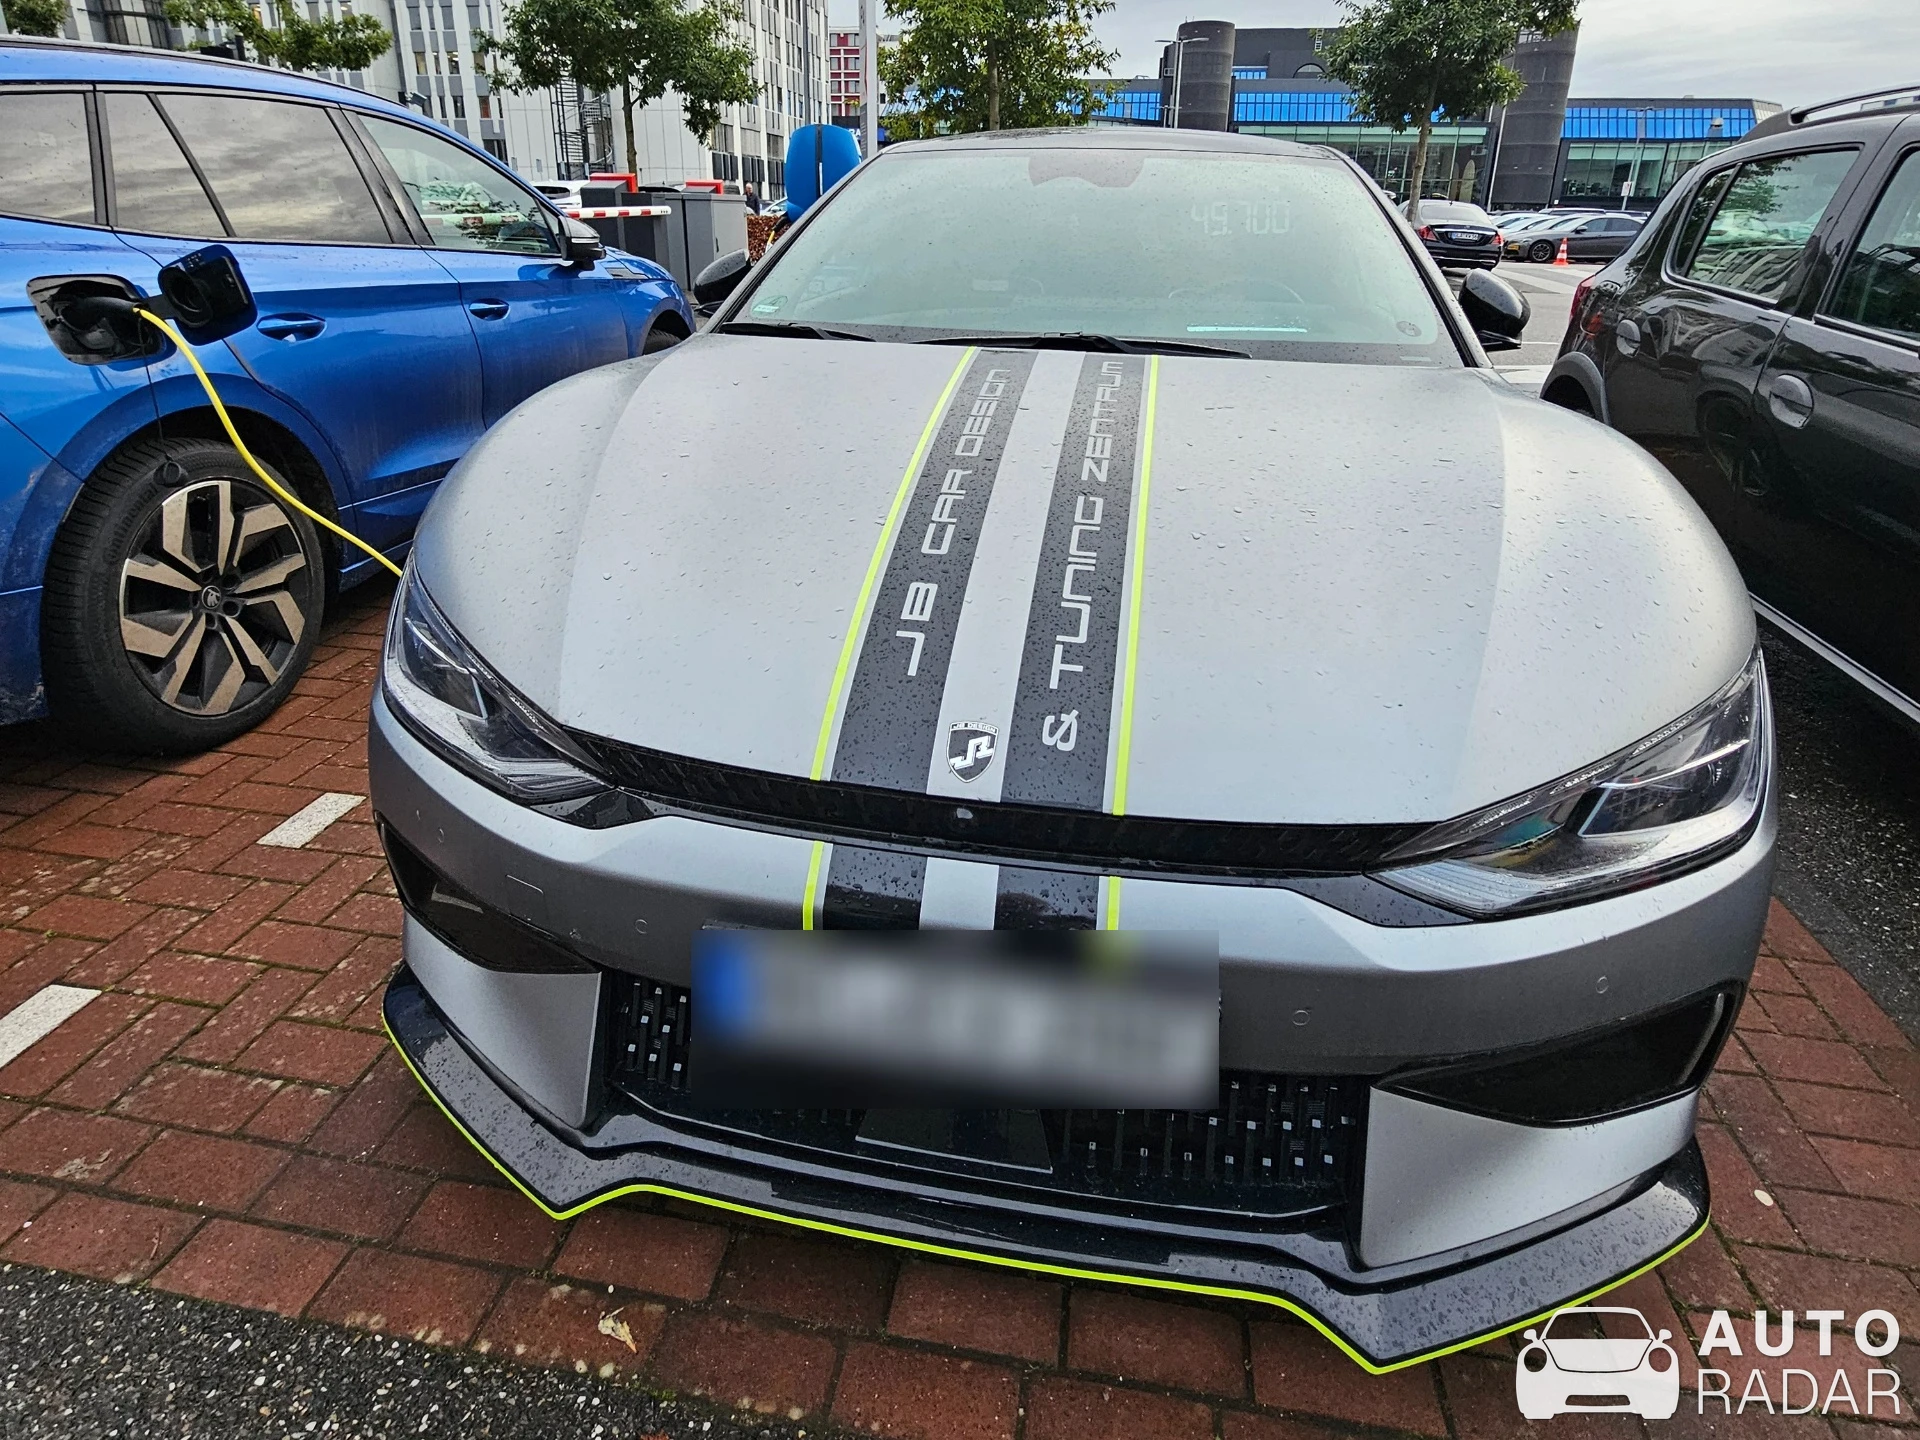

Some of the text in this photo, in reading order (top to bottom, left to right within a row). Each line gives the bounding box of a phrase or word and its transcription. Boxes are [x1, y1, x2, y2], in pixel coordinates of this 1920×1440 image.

[1190, 201, 1290, 236] 49.700
[896, 369, 1011, 676] JB CAR DESIGN
[1041, 361, 1124, 752] & TUNING ZENTRUM
